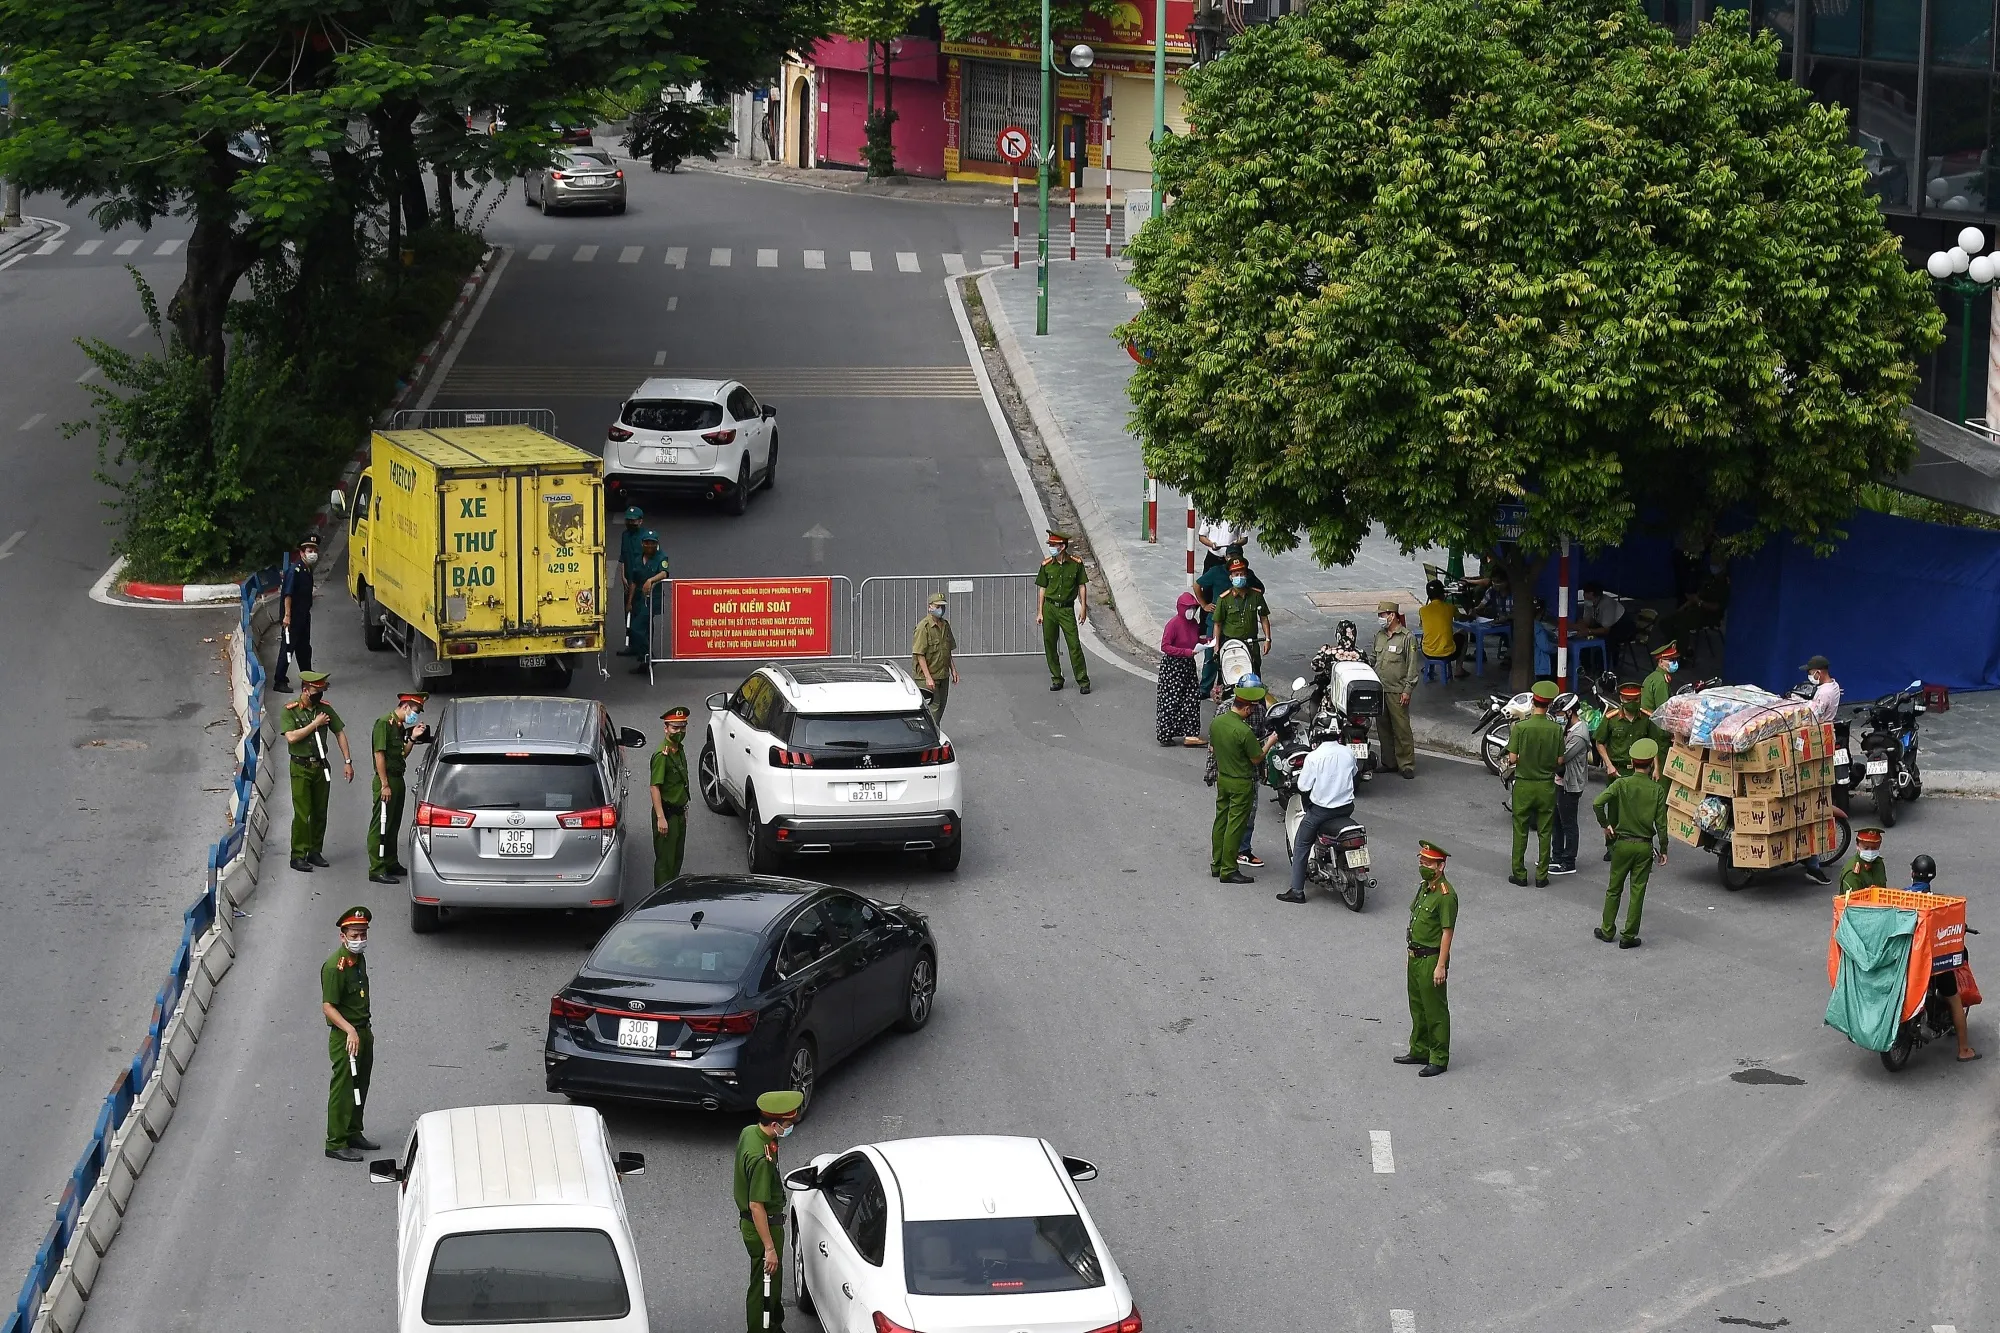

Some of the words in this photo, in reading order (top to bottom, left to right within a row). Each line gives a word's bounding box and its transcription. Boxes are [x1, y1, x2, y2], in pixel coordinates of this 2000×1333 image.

[460, 498, 487, 518] XE
[454, 529, 497, 553] THƯ
[556, 547, 574, 558] 29C
[548, 563, 565, 574] 429
[567, 562, 579, 573] 92
[452, 561, 495, 588] BÁO
[713, 598, 737, 613] CHỐT
[740, 598, 764, 613] KIỂM
[767, 599, 791, 613] SOÁT
[736, 616, 743, 625] SỐ
[521, 657, 545, 667] 429.92
[859, 783, 876, 791] 30G
[852, 792, 883, 800] 827.18
[507, 831, 525, 842] 30F
[500, 843, 533, 854] 426.59
[1947, 923, 1963, 936] GHN
[629, 1021, 649, 1033] 30G
[619, 1033, 654, 1048] 034.82
